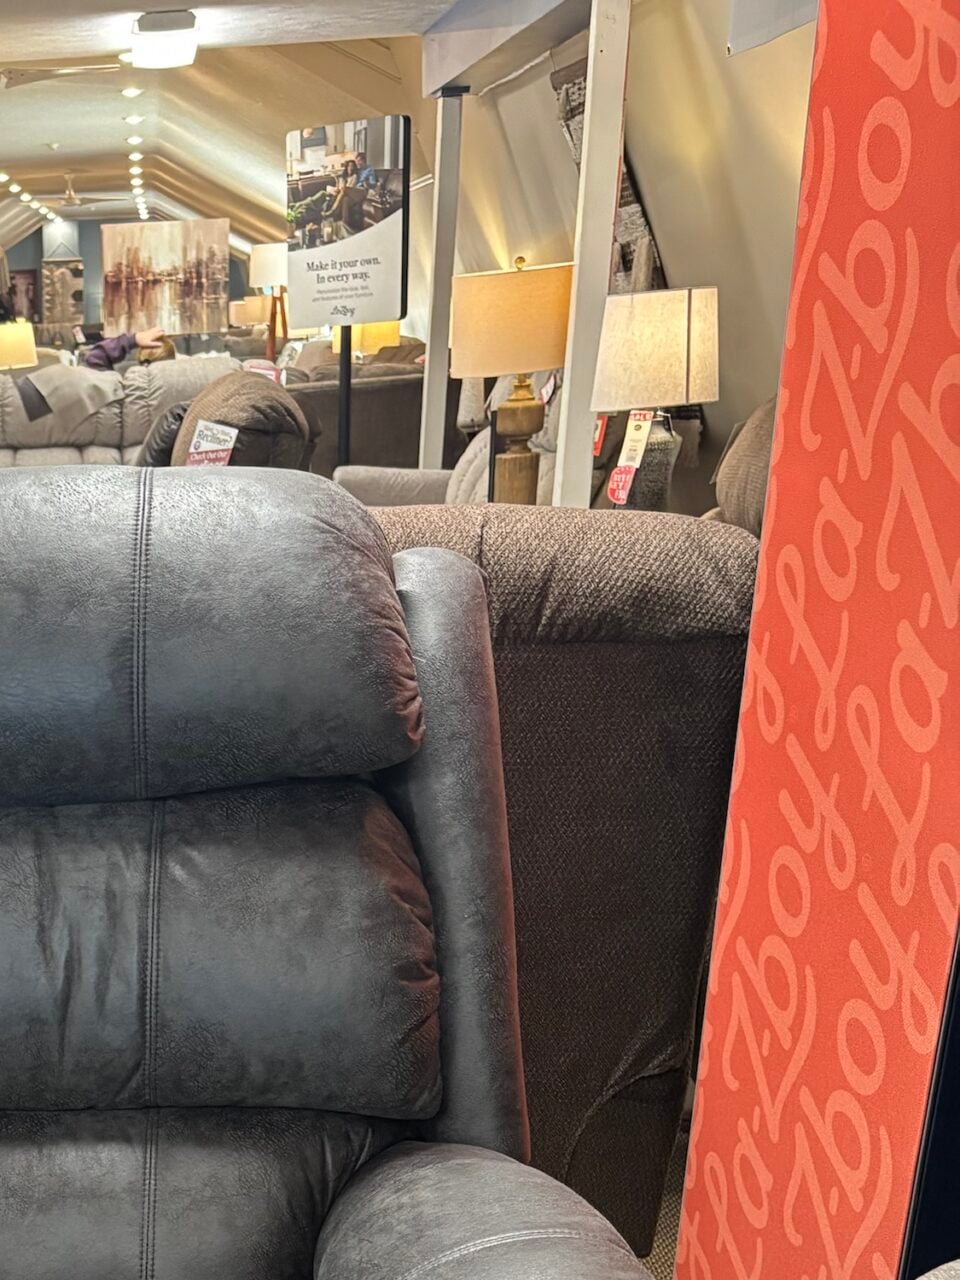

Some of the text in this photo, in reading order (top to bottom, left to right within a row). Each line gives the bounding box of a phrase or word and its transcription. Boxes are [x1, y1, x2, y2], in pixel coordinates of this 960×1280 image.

[306, 257, 381, 272] Make it your own.
[317, 272, 371, 284] In every way.
